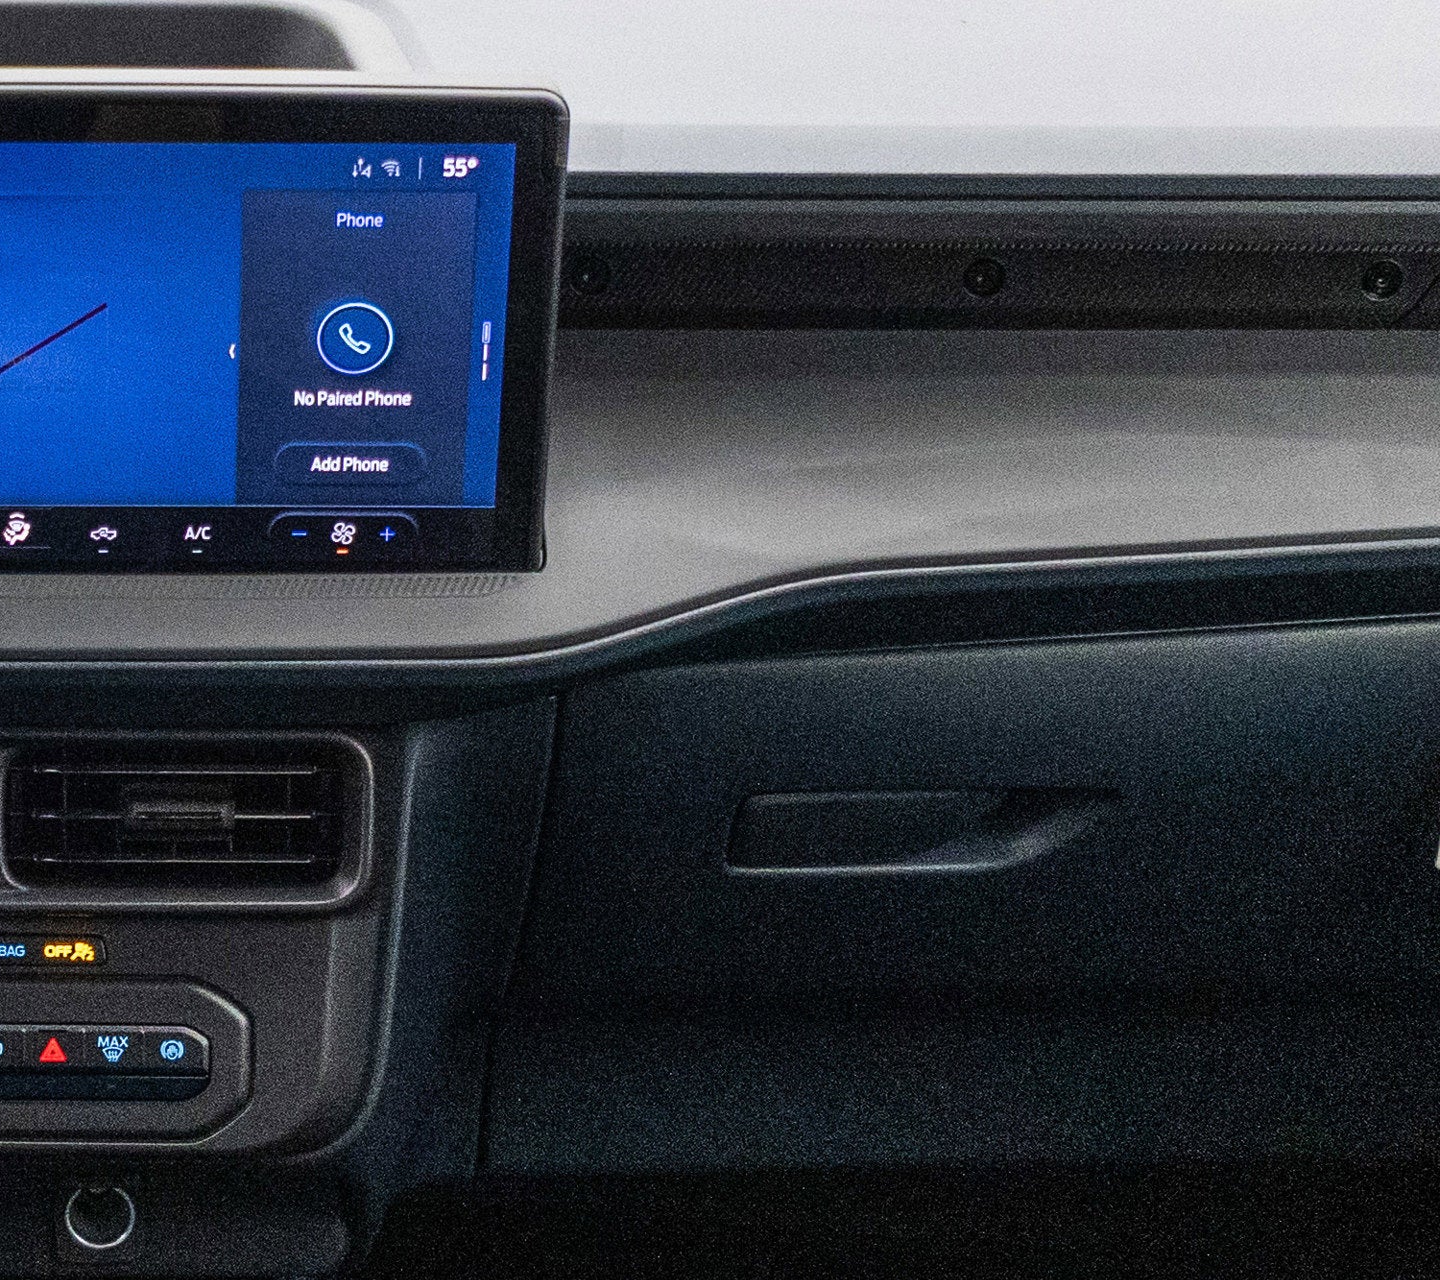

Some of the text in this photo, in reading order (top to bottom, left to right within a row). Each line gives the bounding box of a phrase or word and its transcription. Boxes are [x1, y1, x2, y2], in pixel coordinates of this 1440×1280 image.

[442, 157, 479, 178] 55°
[335, 212, 384, 229] Phone
[294, 390, 412, 407] No Paired Phone
[311, 456, 389, 472] Add Phone
[184, 523, 212, 541] A/C
[43, 943, 72, 959] OFF
[97, 1035, 129, 1049] MAX
